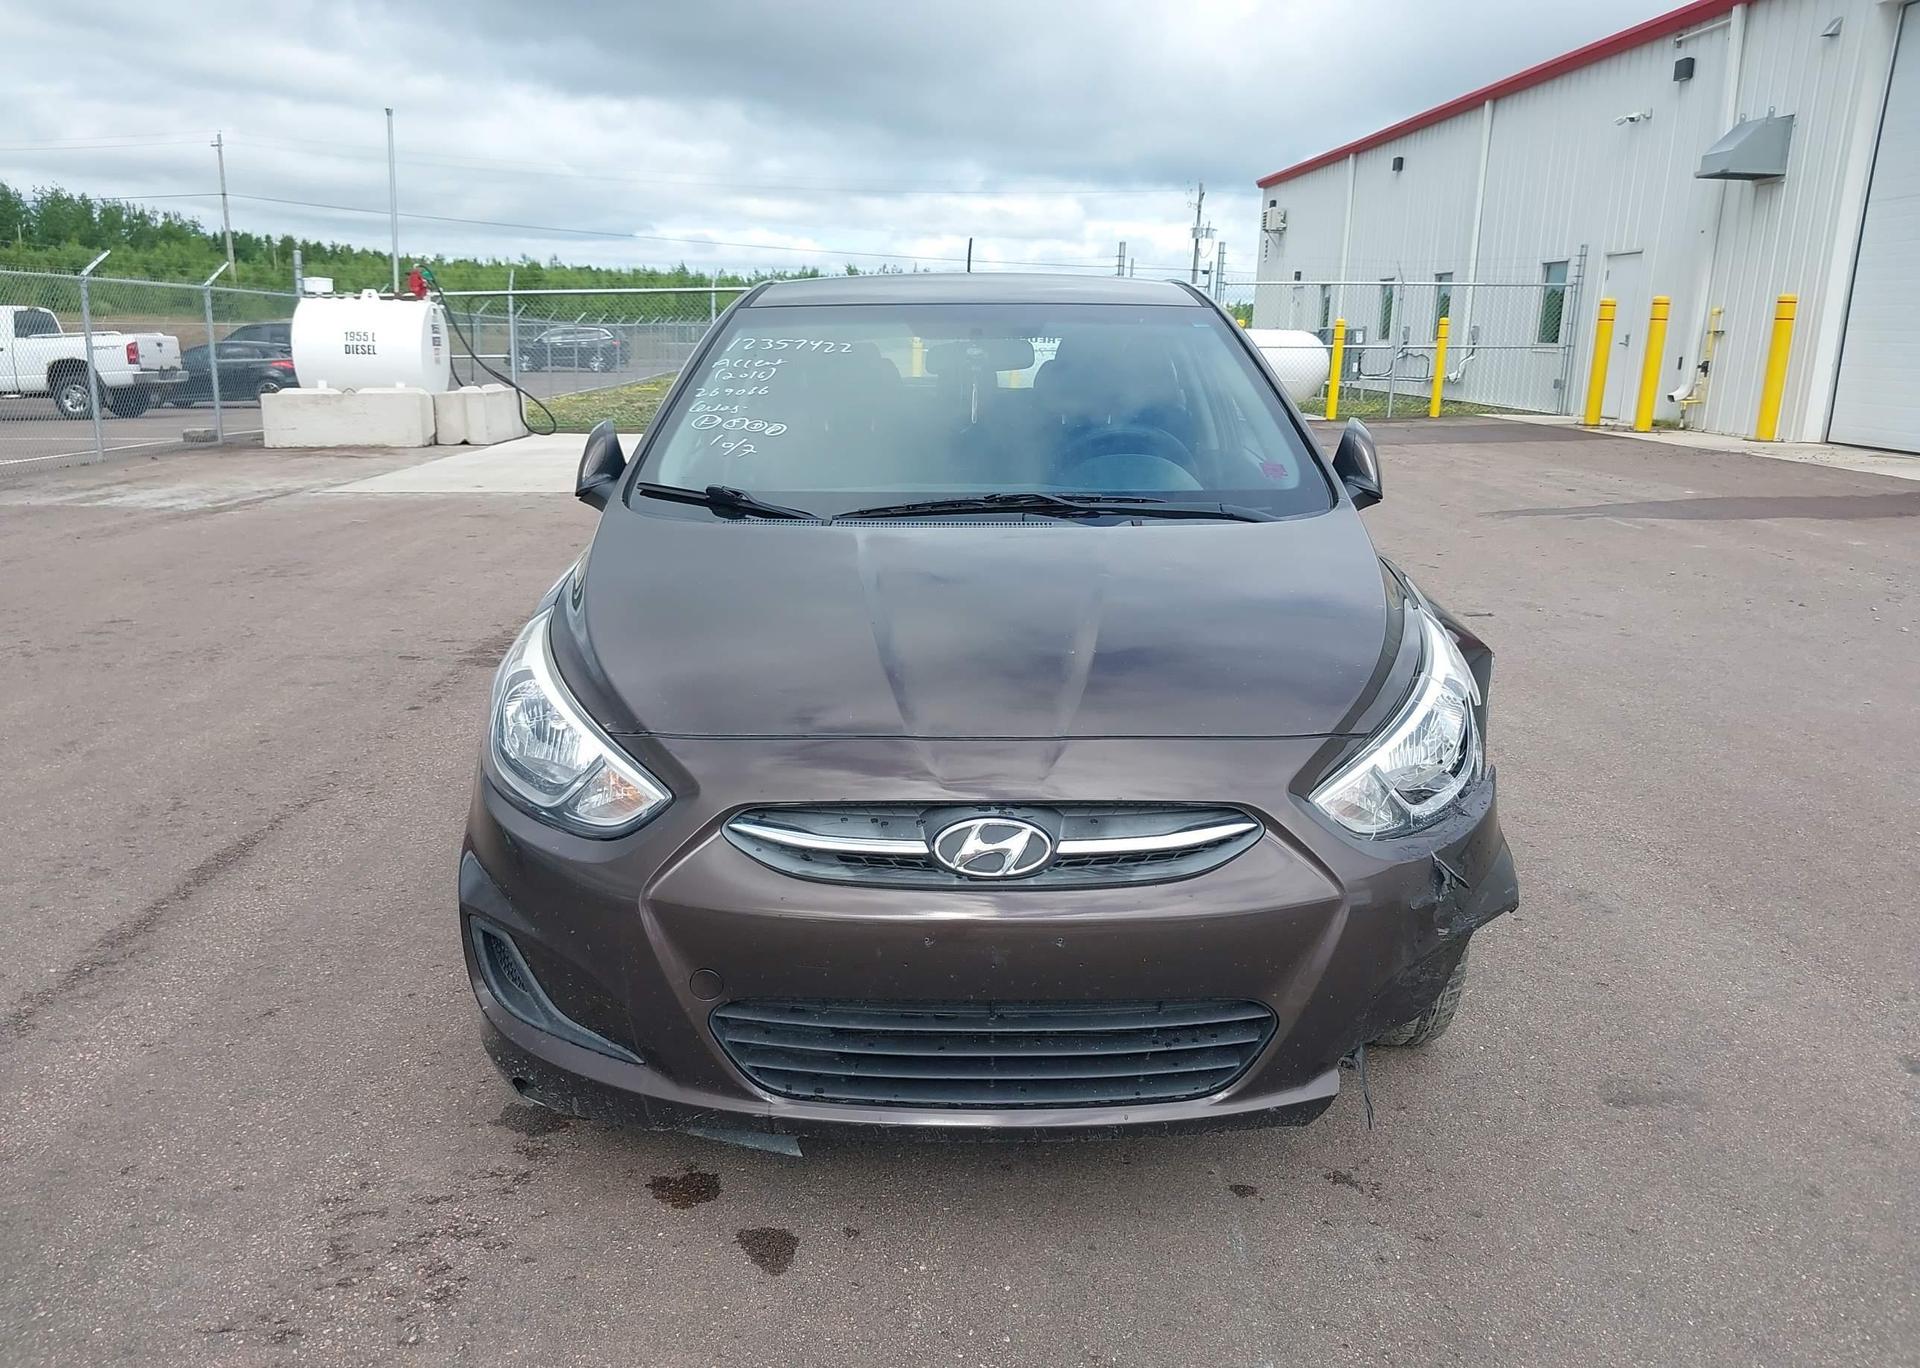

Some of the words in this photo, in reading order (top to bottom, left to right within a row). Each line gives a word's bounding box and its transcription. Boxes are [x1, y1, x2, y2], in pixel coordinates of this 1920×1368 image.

[344, 331, 369, 342] 1955
[372, 331, 376, 342] L
[344, 344, 377, 355] DIESEL
